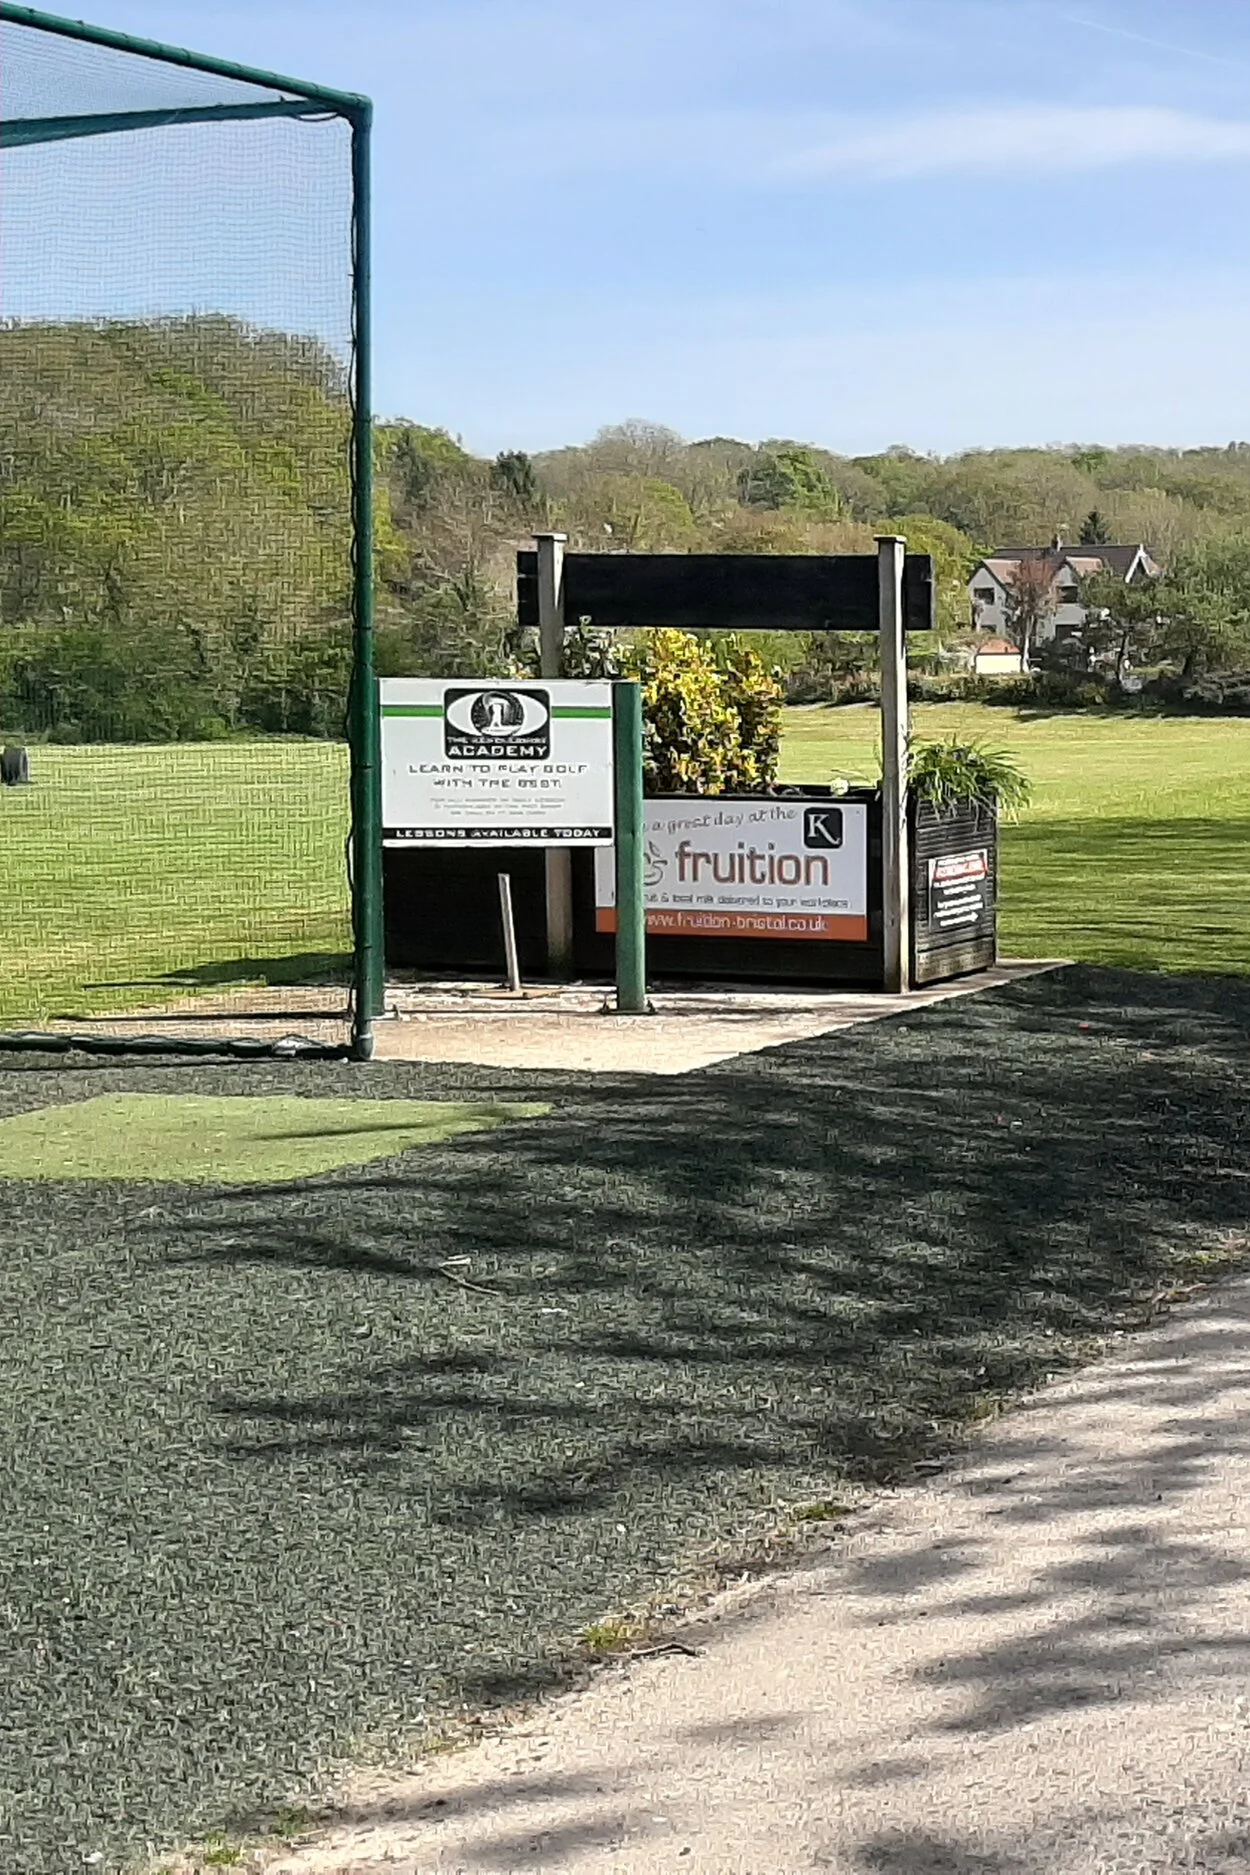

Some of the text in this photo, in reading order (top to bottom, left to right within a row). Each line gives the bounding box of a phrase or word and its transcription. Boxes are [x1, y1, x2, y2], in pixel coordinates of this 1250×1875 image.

[448, 745, 548, 757] ACADEMY
[408, 764, 588, 775] LEARN TO PLAY GOLF
[433, 778, 473, 788] WITH
[478, 779, 511, 789] THE
[667, 815, 712, 834] great
[714, 812, 744, 827] day
[748, 809, 767, 822] at
[770, 806, 798, 820] the
[395, 829, 601, 839] LESSONS AVAILABLE TODAY
[807, 813, 842, 845] K
[675, 840, 830, 886] fruition
